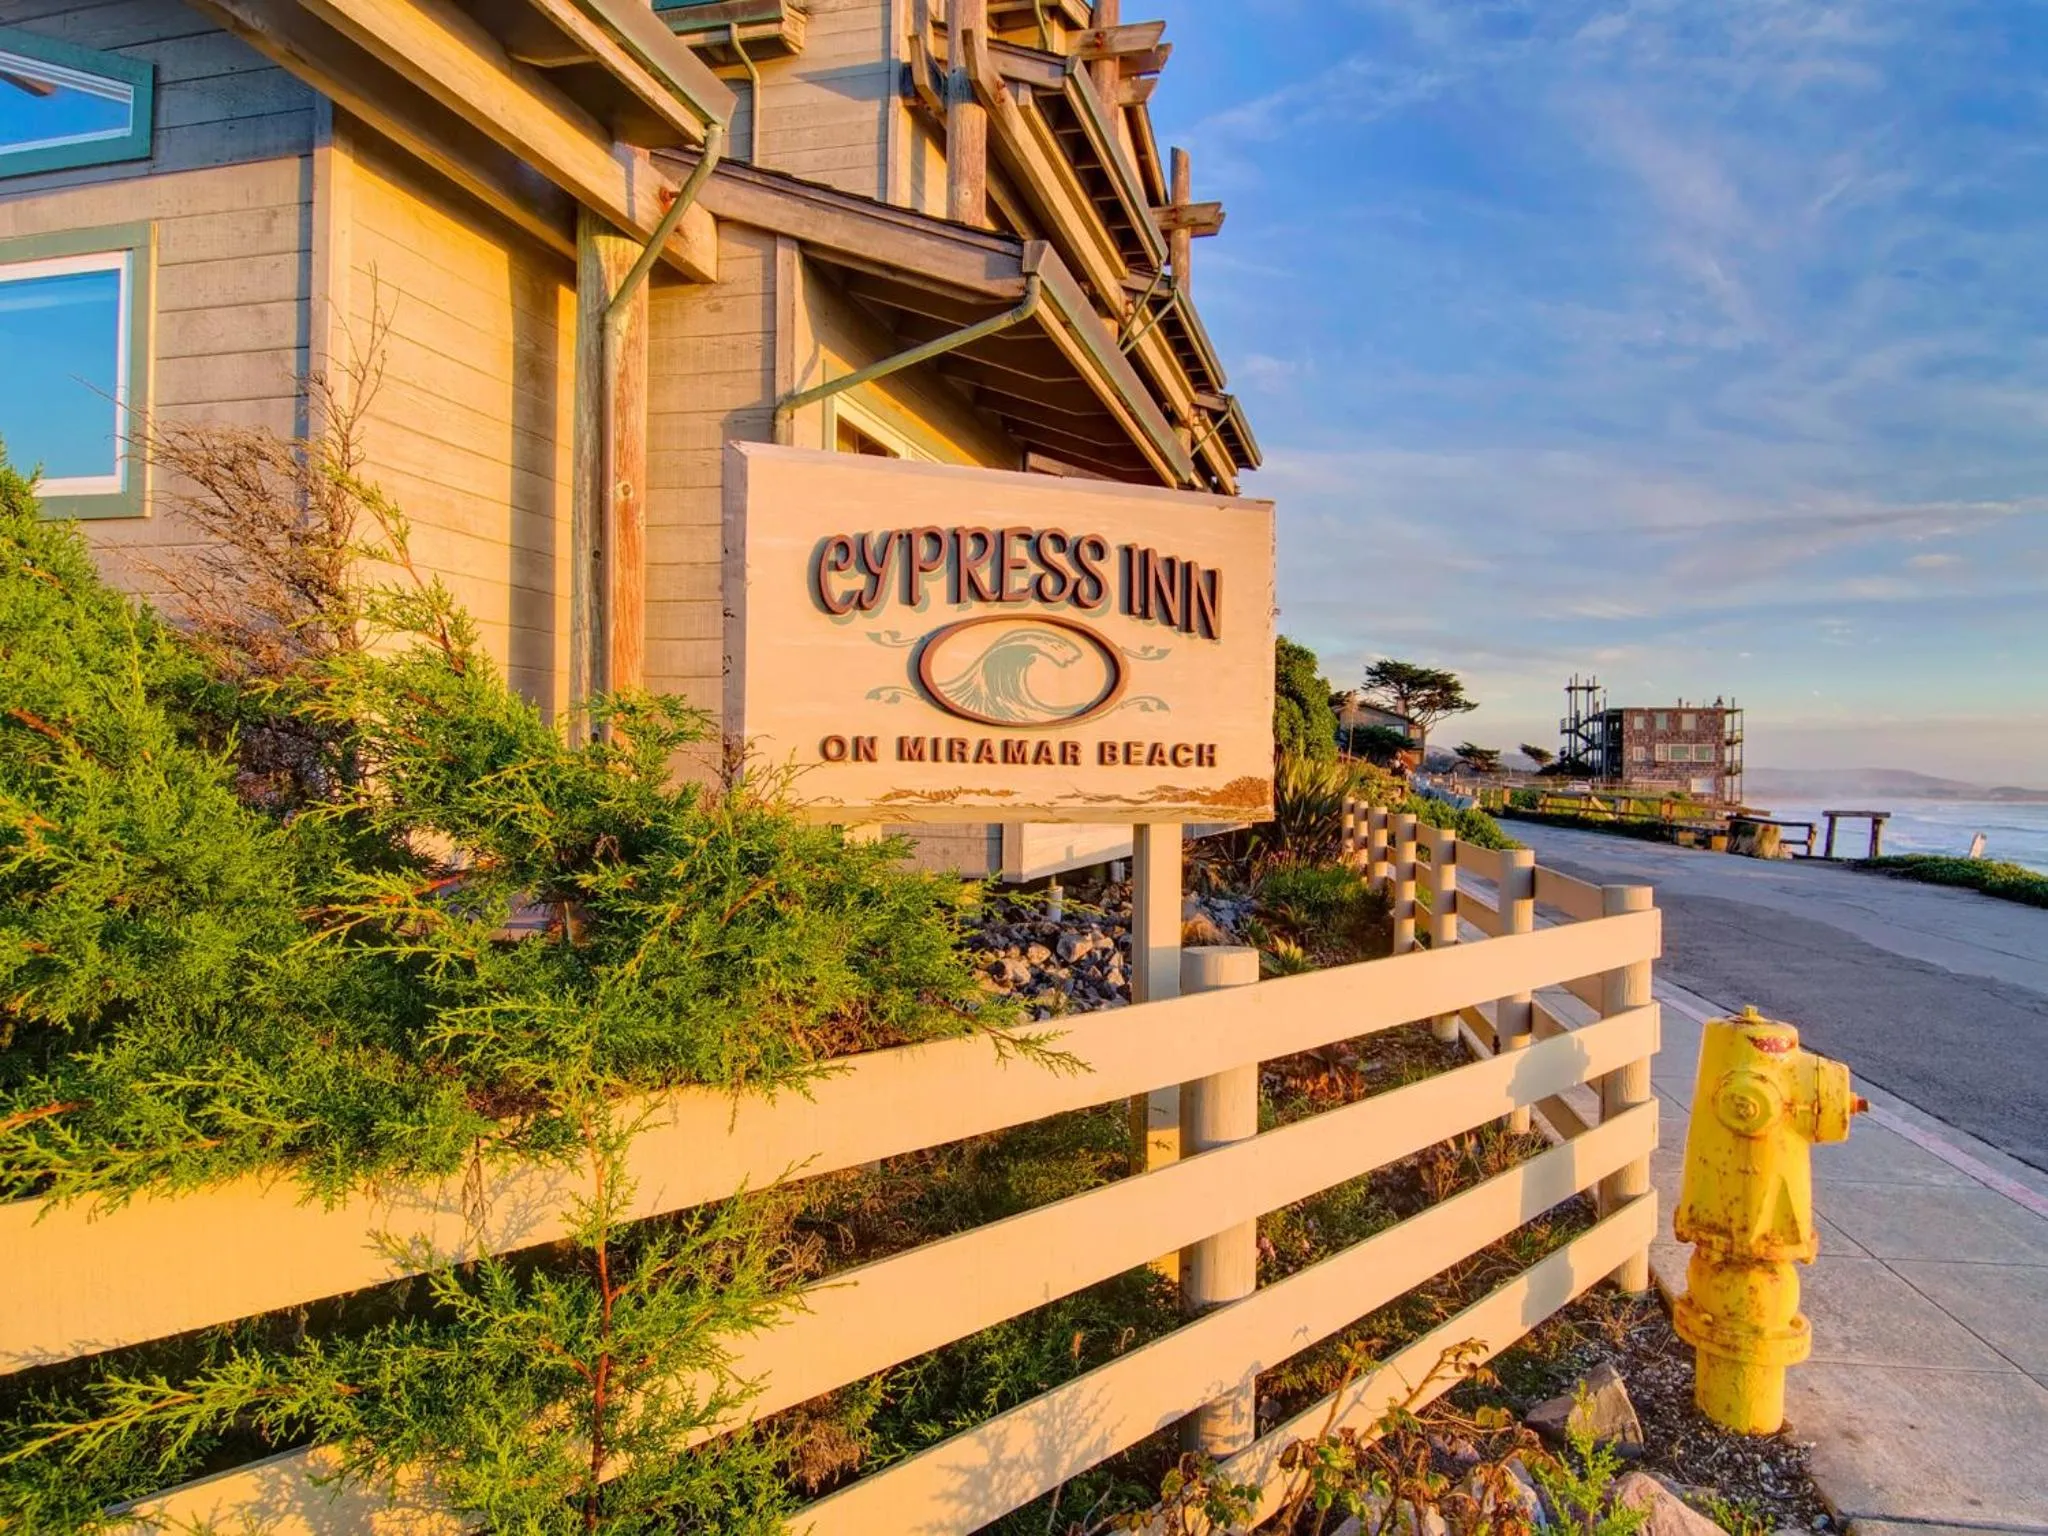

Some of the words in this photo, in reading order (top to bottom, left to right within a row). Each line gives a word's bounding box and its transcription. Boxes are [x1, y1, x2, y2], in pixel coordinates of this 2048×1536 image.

[814, 525, 1111, 618] CYPRESS
[1117, 542, 1222, 640] INN
[820, 734, 879, 762] ON
[896, 735, 1083, 767] MIRAMAR
[1098, 740, 1218, 768] BEACH
